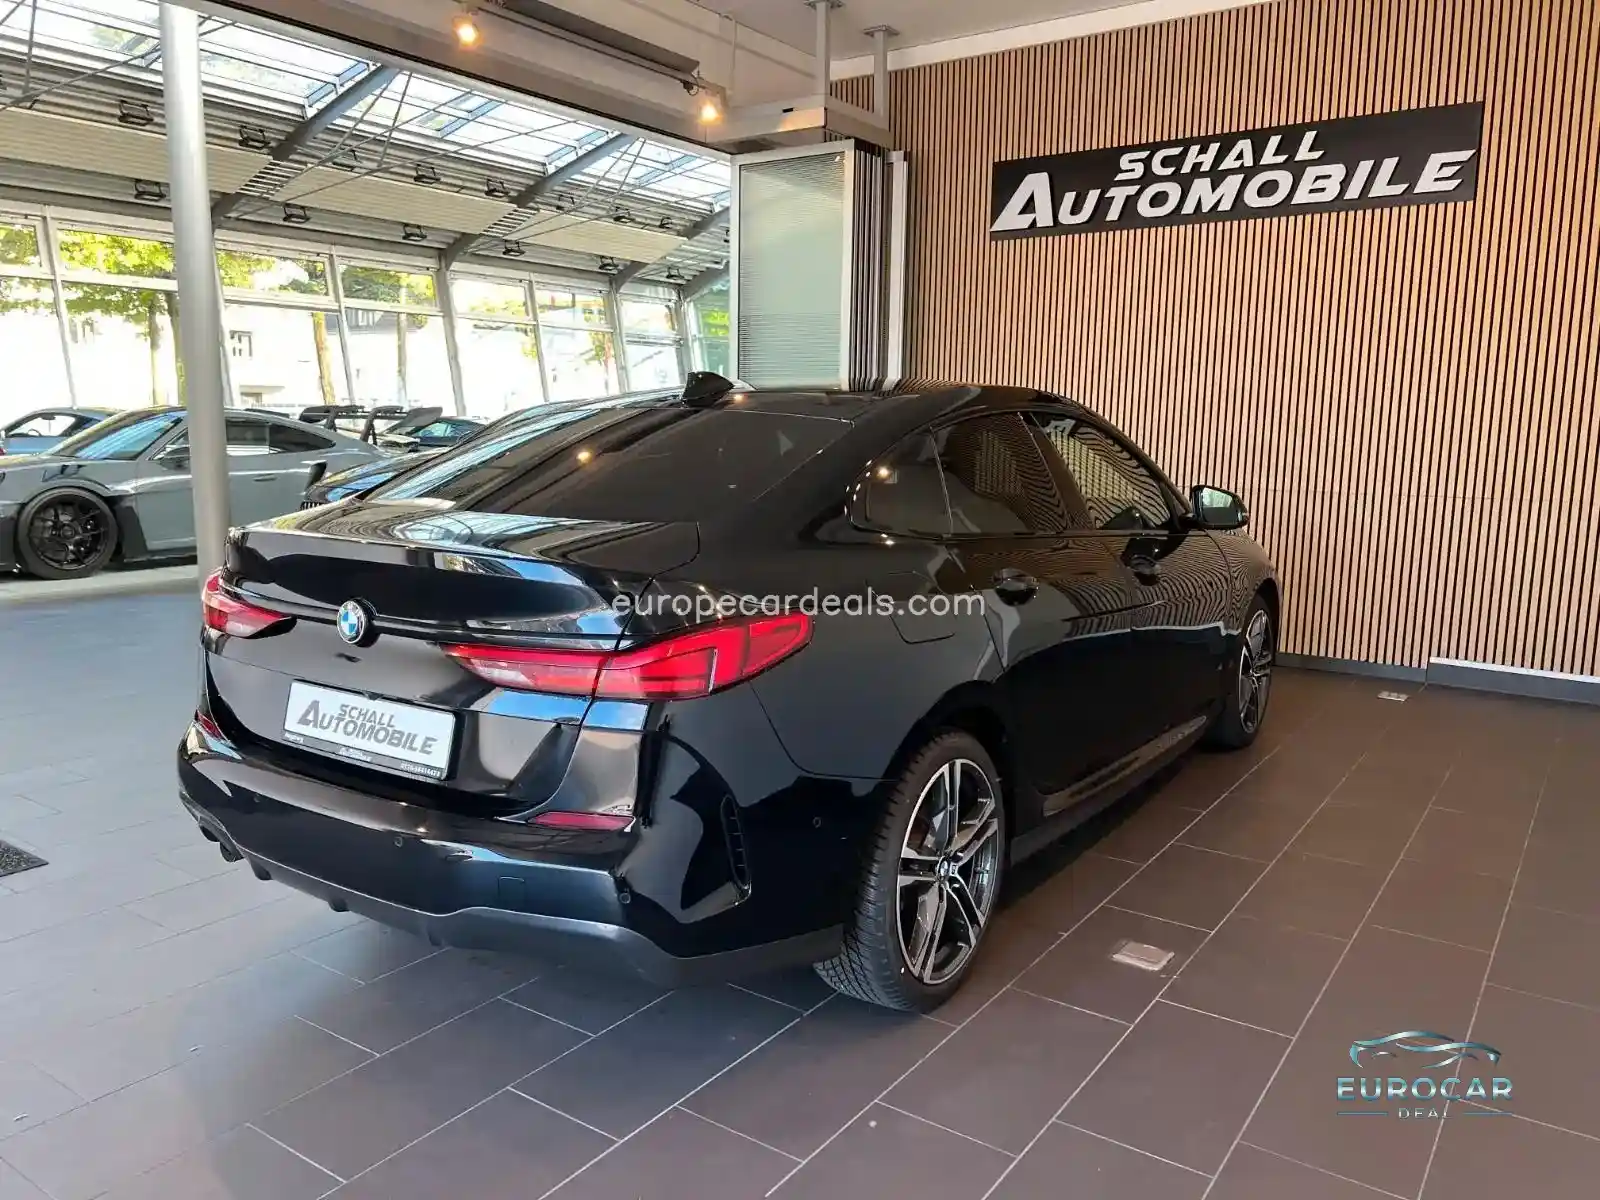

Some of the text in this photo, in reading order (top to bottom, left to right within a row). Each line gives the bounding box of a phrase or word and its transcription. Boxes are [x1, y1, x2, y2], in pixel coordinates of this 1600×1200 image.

[1114, 129, 1326, 181] SCHALL
[990, 149, 1476, 232] AUTOMOBILE
[297, 700, 438, 755] AUTOMOBILE
[337, 703, 396, 728] SCHALL
